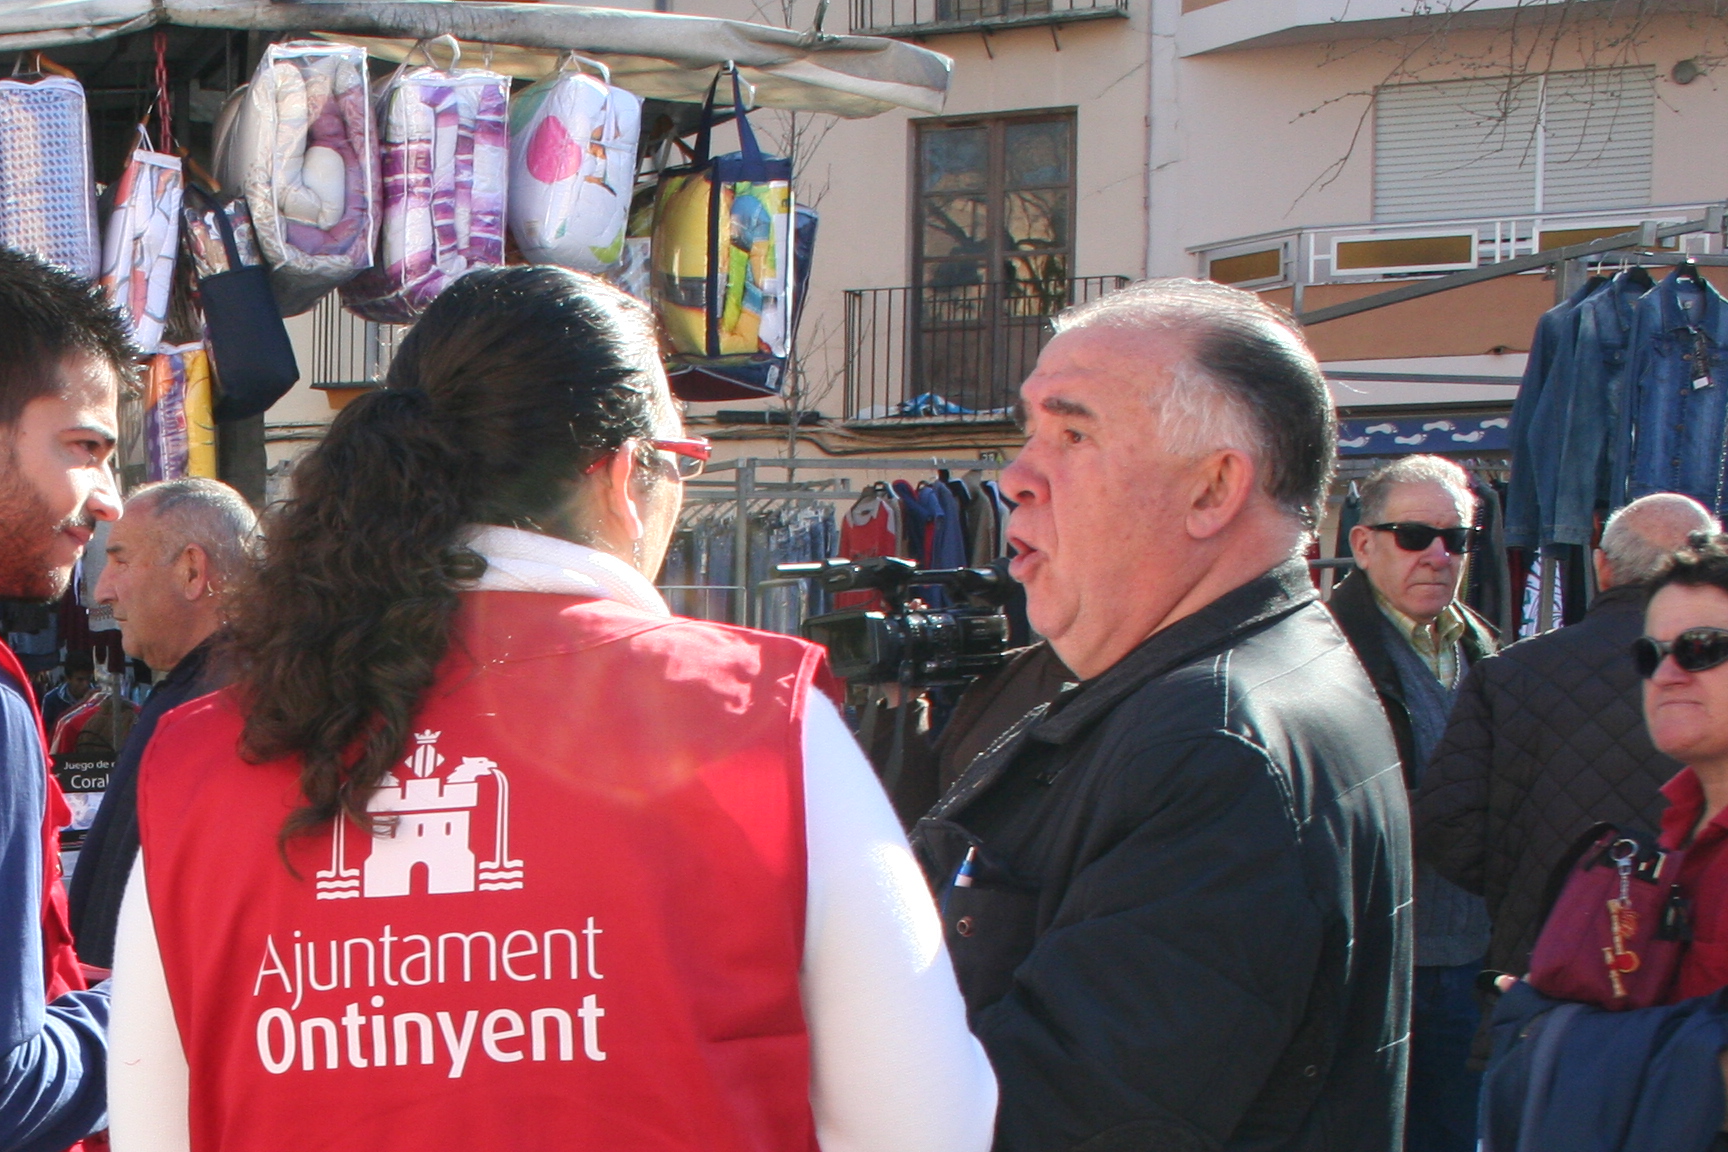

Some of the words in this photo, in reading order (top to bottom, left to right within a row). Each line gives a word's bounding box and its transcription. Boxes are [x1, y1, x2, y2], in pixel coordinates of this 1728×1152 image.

[63, 761, 94, 771] Juego
[96, 760, 109, 768] de
[253, 916, 604, 1011] Ajuntament
[256, 994, 607, 1079] Ontinyent
